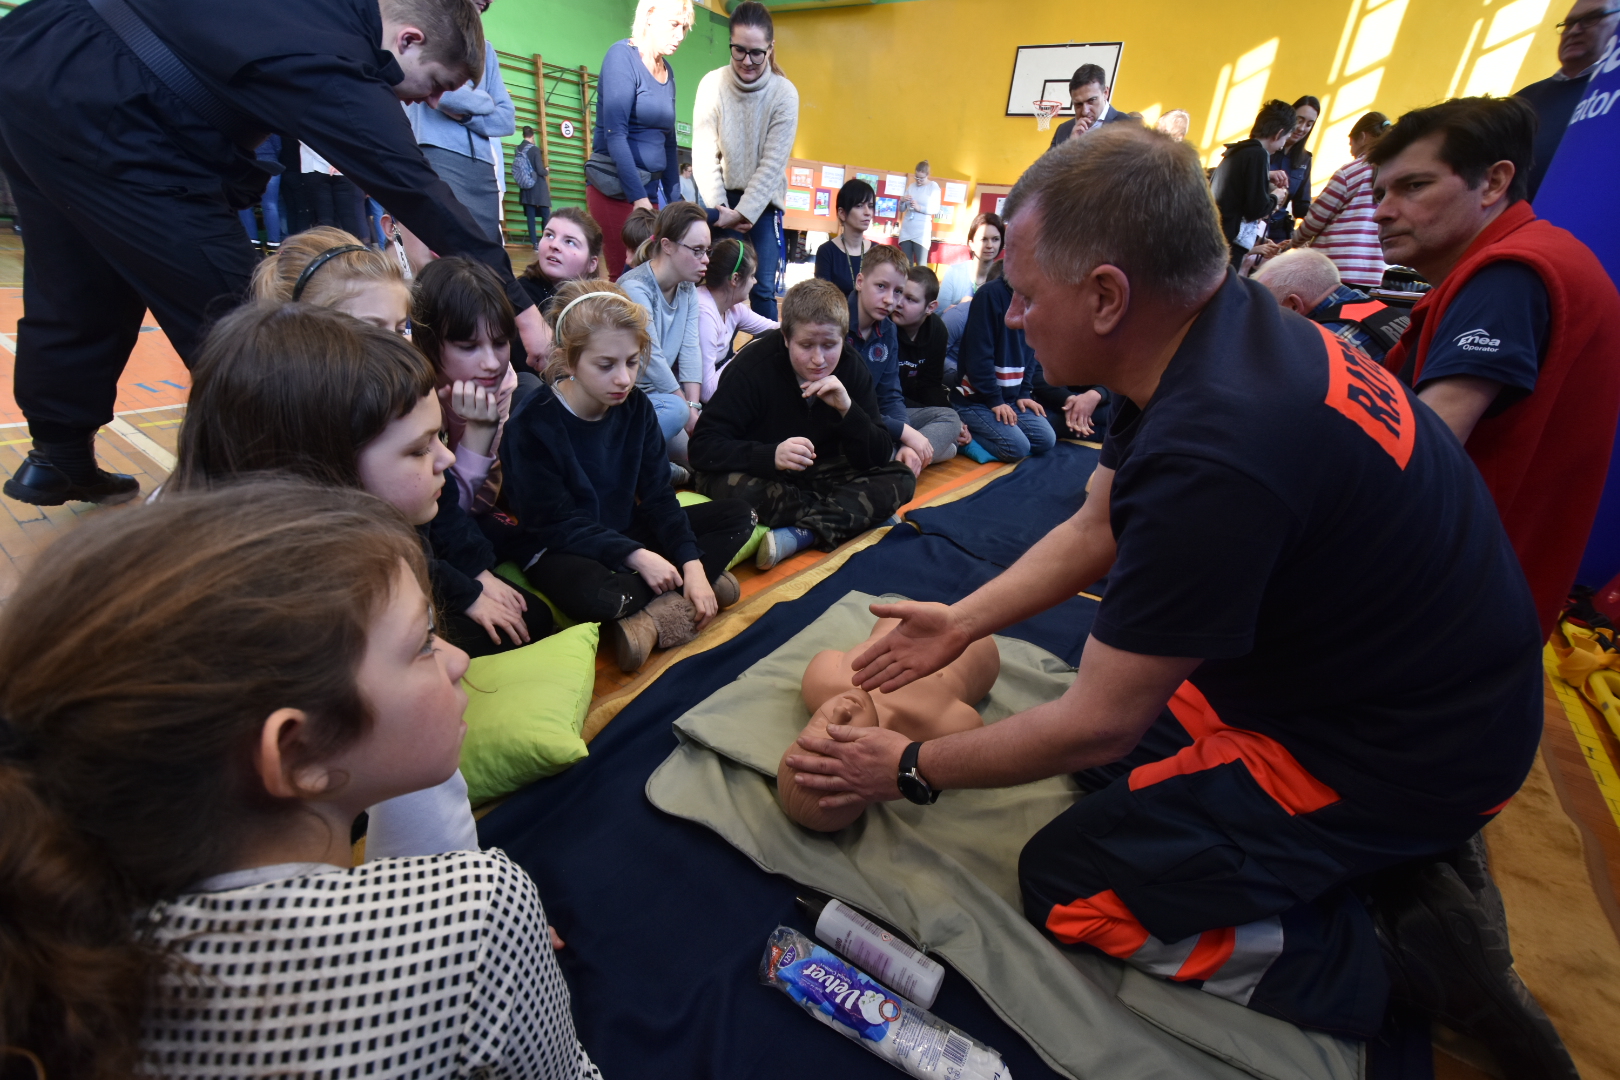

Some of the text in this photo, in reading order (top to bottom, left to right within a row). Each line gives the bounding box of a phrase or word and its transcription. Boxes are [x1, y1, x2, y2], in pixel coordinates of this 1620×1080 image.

[563, 123, 571, 135] 40
[1456, 334, 1501, 347] Enea
[1462, 343, 1500, 353] Operator
[801, 962, 860, 1010] Velvet
